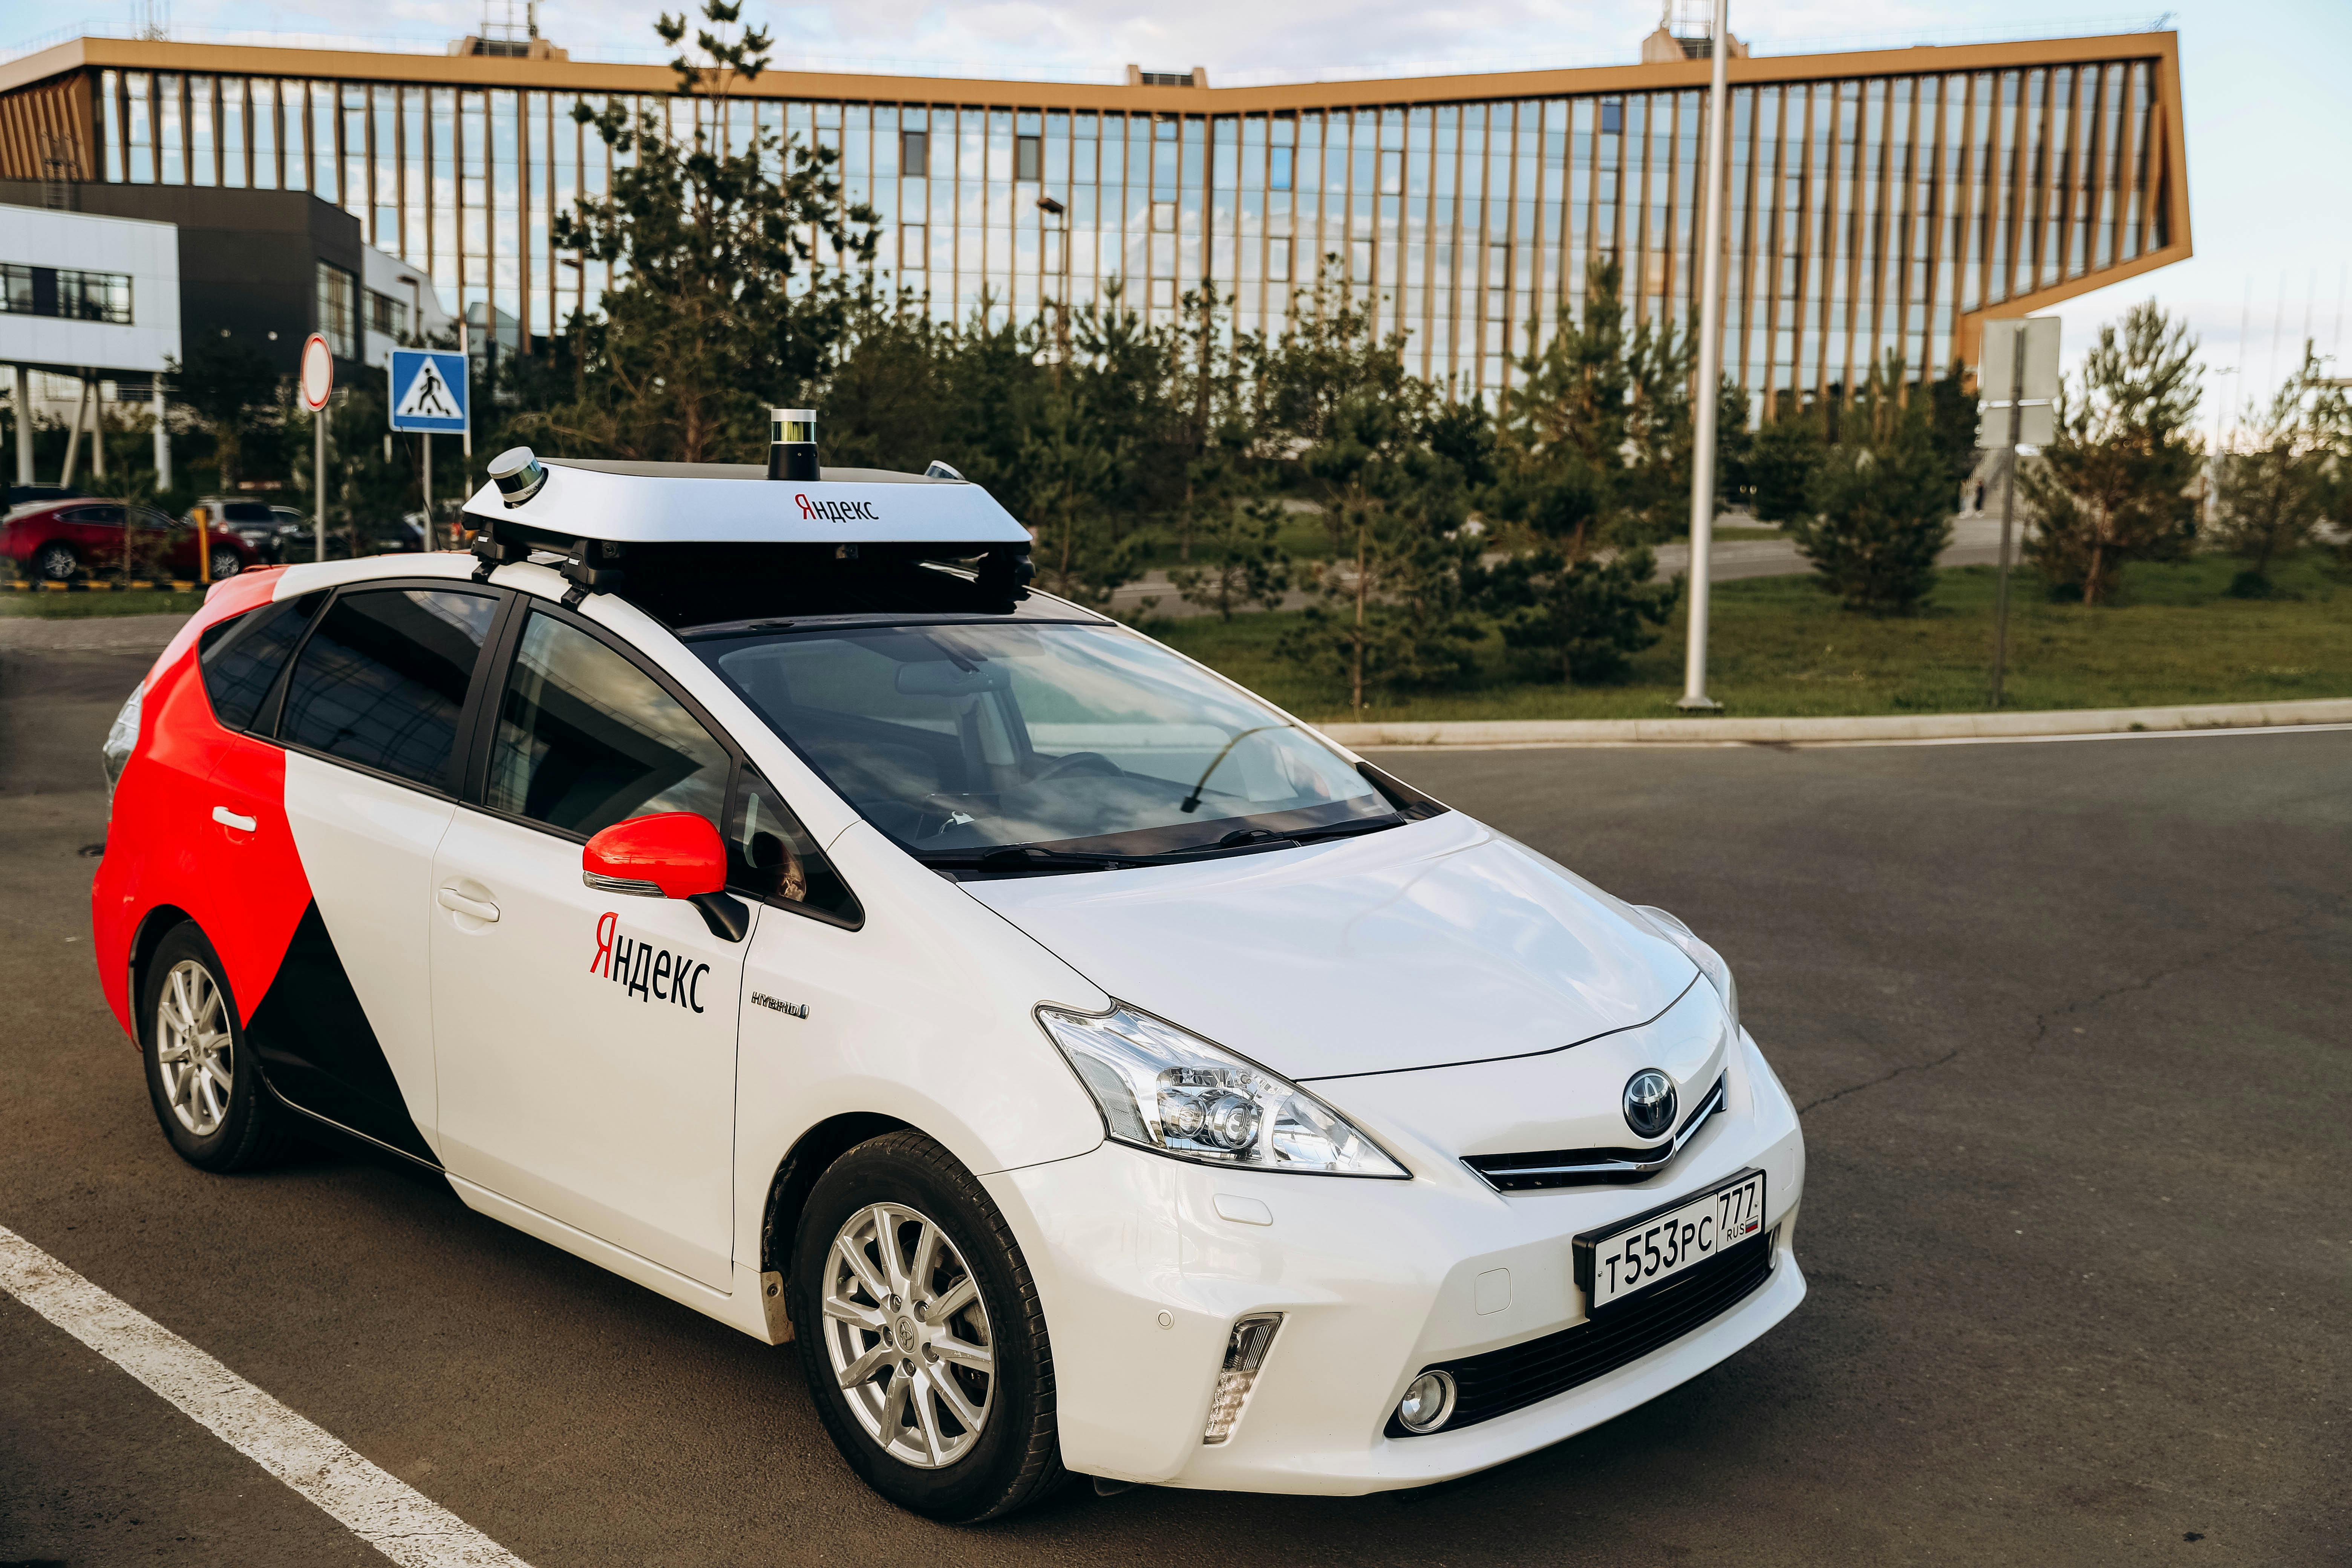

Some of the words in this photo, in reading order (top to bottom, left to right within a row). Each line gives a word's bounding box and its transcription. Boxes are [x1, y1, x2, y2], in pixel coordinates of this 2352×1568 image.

[795, 494, 880, 523] Яндекс
[590, 911, 710, 1013] Яндекс
[751, 991, 800, 1017] HYBRID
[1719, 1181, 1756, 1230] 777
[1726, 1223, 1745, 1242] RUS
